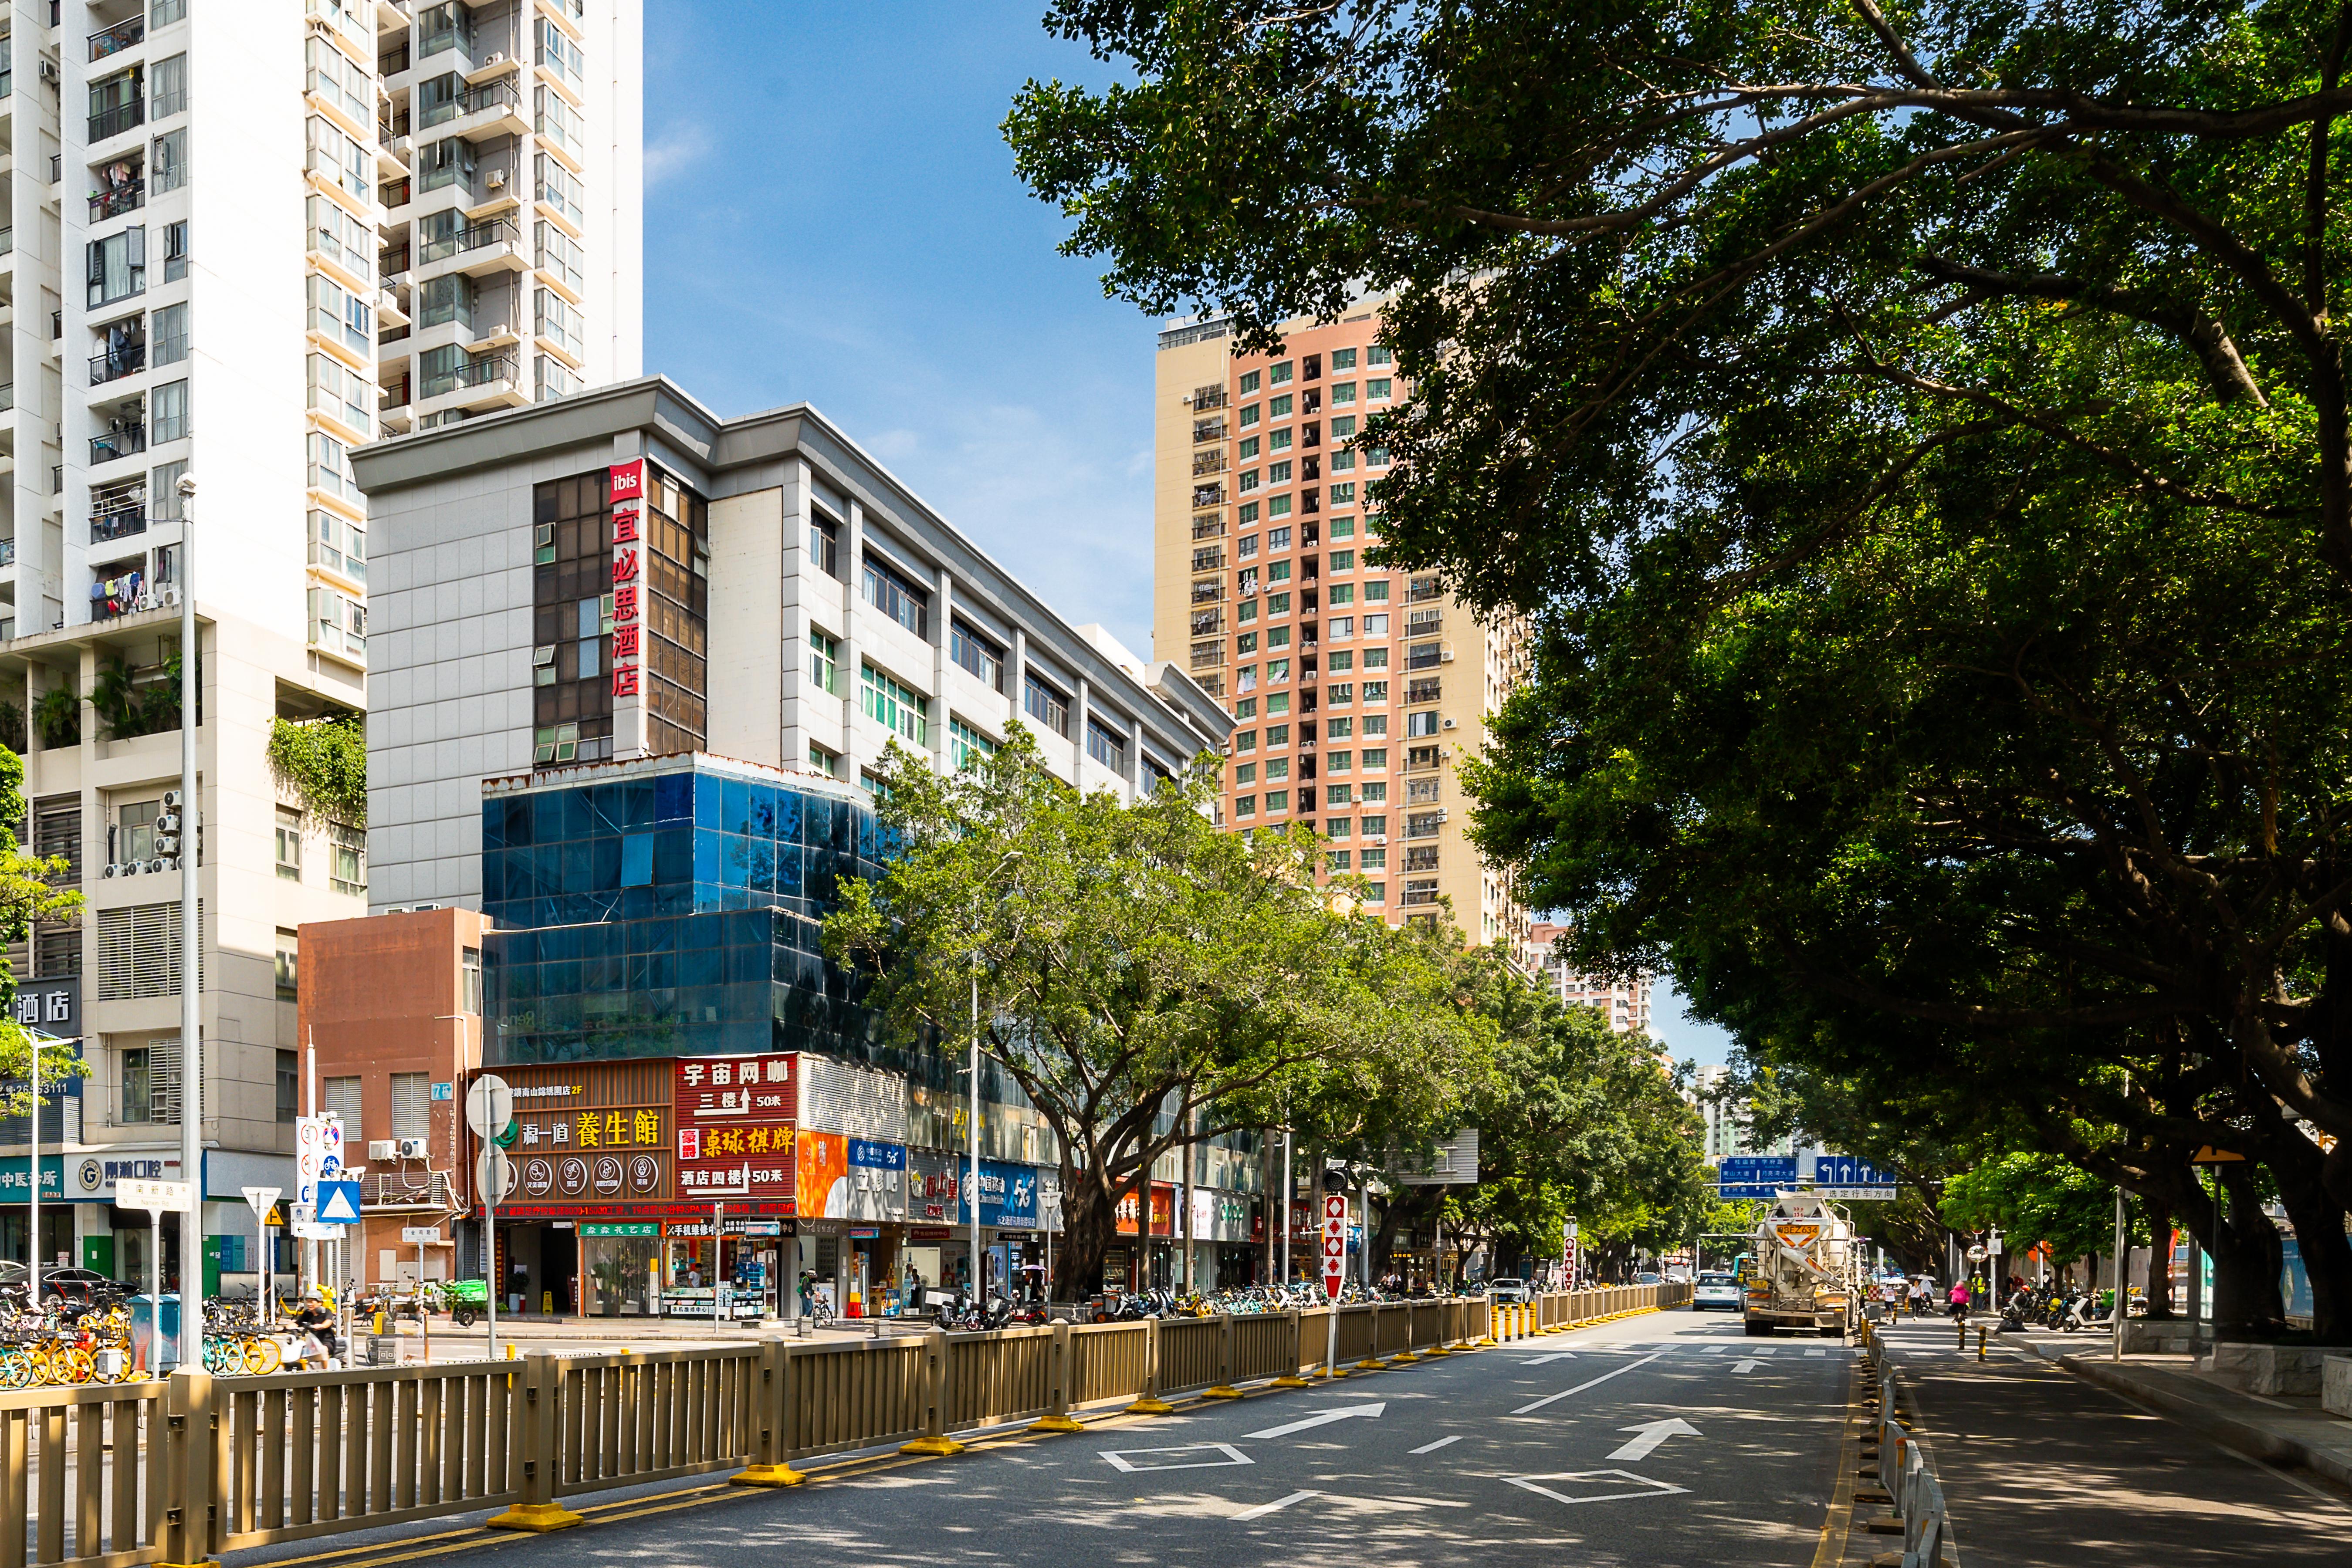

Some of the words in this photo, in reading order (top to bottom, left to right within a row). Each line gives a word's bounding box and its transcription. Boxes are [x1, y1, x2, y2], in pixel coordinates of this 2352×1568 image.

[613, 473, 636, 491] ibis
[612, 508, 640, 697] 宜必思酒店
[684, 1060, 788, 1086] 宇宙网咖
[572, 1086, 582, 1094] 2F
[700, 1092, 736, 1108] 三楼
[756, 1095, 781, 1107] 50米
[522, 1123, 569, 1145] 源一道
[575, 1109, 660, 1147] 養生館
[682, 1130, 696, 1158] 豪爵
[701, 1126, 795, 1158] 桌球棋牌
[681, 1169, 741, 1185] 酒店四楼
[752, 1169, 782, 1182] 50米
[979, 1174, 1005, 1193] 中国移动
[136, 1184, 174, 1196] 南新路
